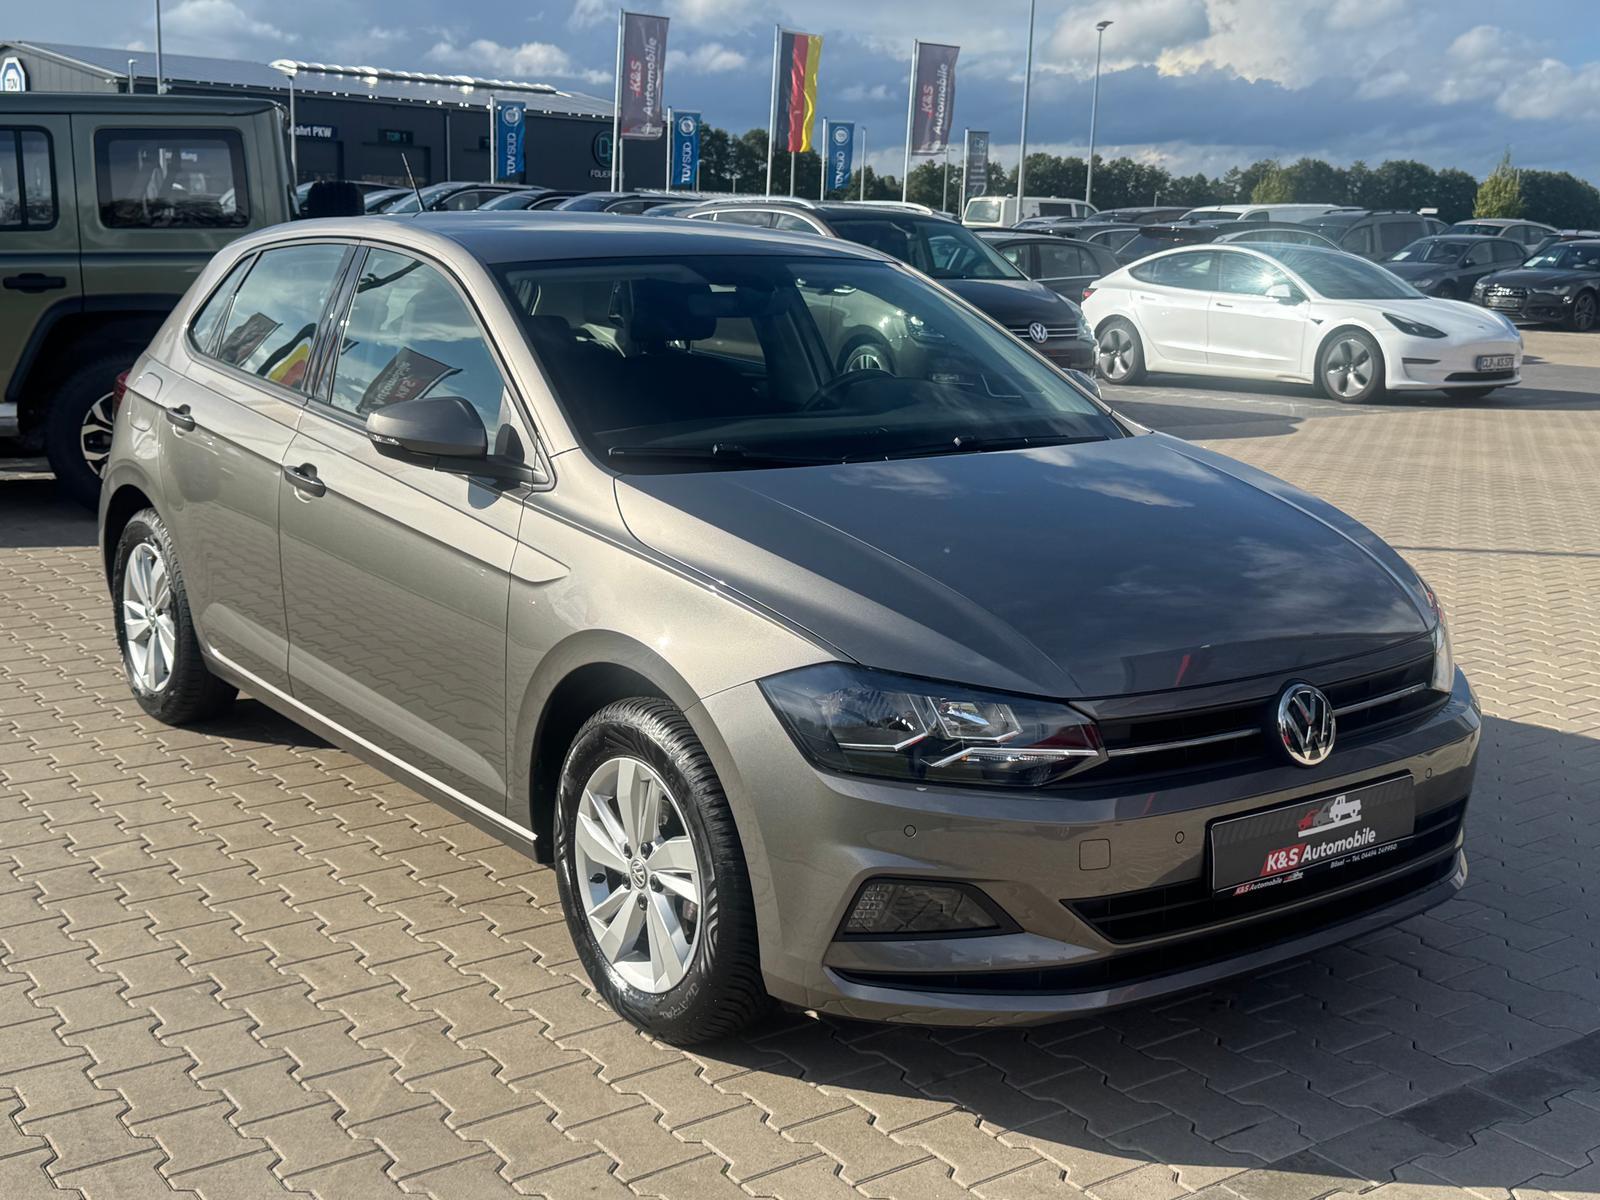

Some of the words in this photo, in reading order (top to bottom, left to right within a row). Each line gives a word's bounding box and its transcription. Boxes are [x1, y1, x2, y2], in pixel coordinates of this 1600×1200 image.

[629, 60, 642, 94] K&S
[643, 37, 657, 118] Automobile
[921, 84, 934, 114] K&S
[933, 63, 948, 136] Automobile
[312, 127, 332, 138] PKW
[1266, 847, 1299, 872] K&S
[1301, 826, 1376, 863] Automobile
[1249, 877, 1283, 892] Automobile
